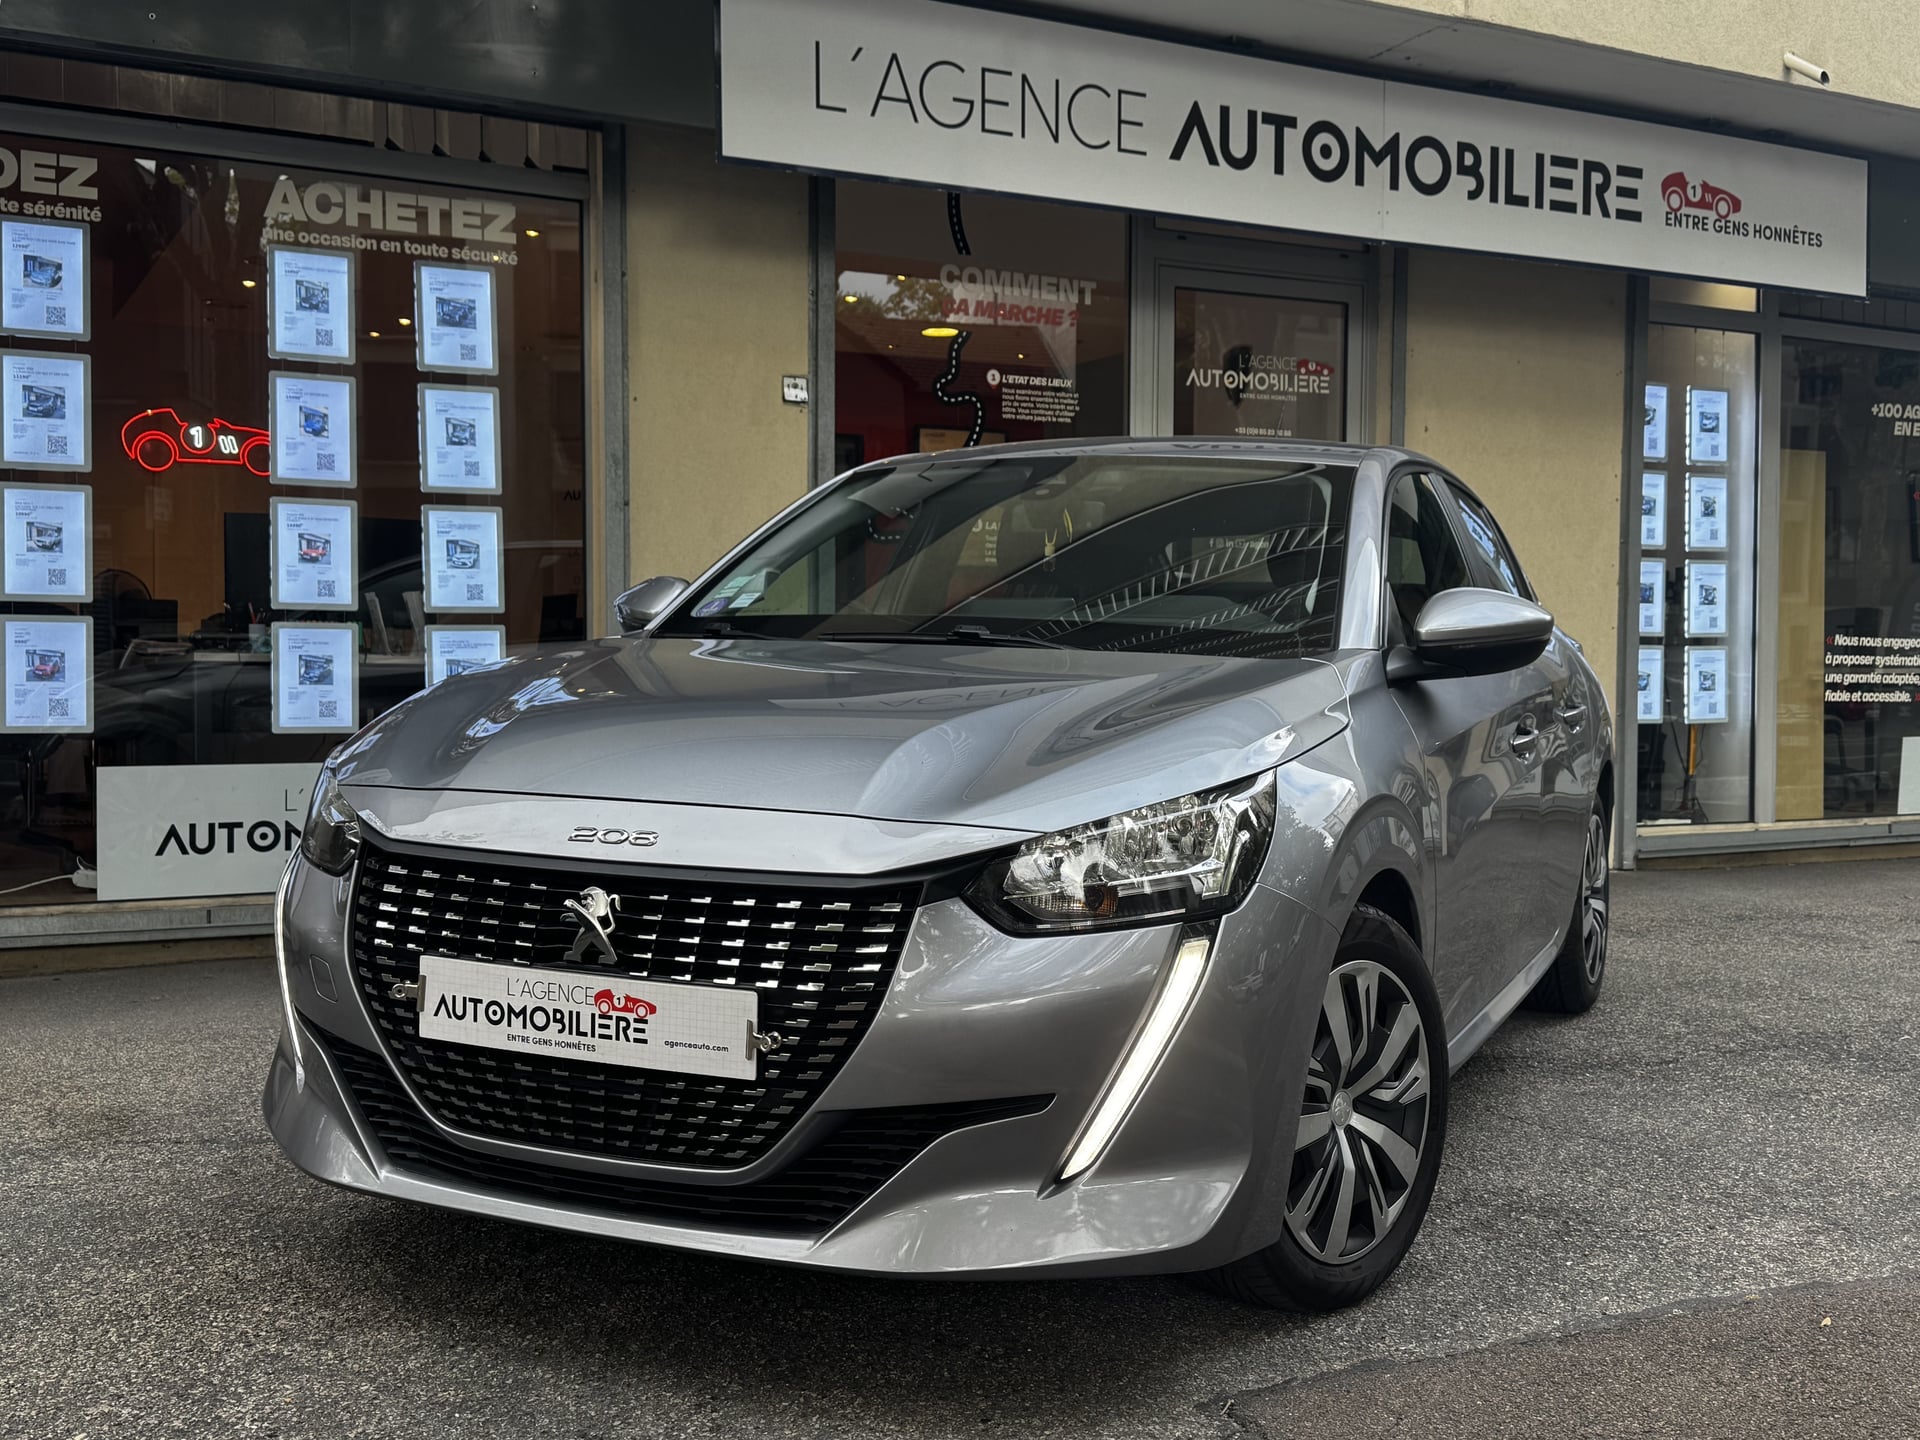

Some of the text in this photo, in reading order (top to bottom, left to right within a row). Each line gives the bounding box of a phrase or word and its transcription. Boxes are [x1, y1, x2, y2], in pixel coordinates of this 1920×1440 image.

[815, 40, 1644, 223] L'AGENCE AUTOMOBILIERE
[23, 200, 102, 222] sérénité
[263, 179, 517, 245] ACHETEZ
[1665, 211, 1823, 248] ENTRE GENS HONNÊTES
[298, 230, 378, 252] occasion
[380, 239, 402, 253] en
[404, 240, 448, 259] toute
[940, 263, 1097, 305] COMMENT
[974, 300, 1065, 326] MARCHE
[1030, 376, 1047, 386] DES
[1048, 377, 1072, 388] LIEUX
[1871, 403, 1902, 418] +100
[1894, 421, 1912, 436] EN
[1834, 634, 1859, 647] Nous
[1859, 636, 1882, 647] nous
[1825, 652, 1832, 665] à
[1832, 654, 1875, 667] proposer
[1825, 673, 1843, 683] une
[1843, 672, 1882, 685] garantie
[1824, 689, 1851, 702] fiable
[1851, 691, 1861, 702] et
[1862, 690, 1912, 703] accessible.
[567, 825, 660, 847] 208
[433, 993, 649, 1045] AUTOMOBILIERE
[507, 1033, 597, 1053] ENTRE GENS HONNÊTES
[664, 1039, 729, 1053] agenceauto.com
